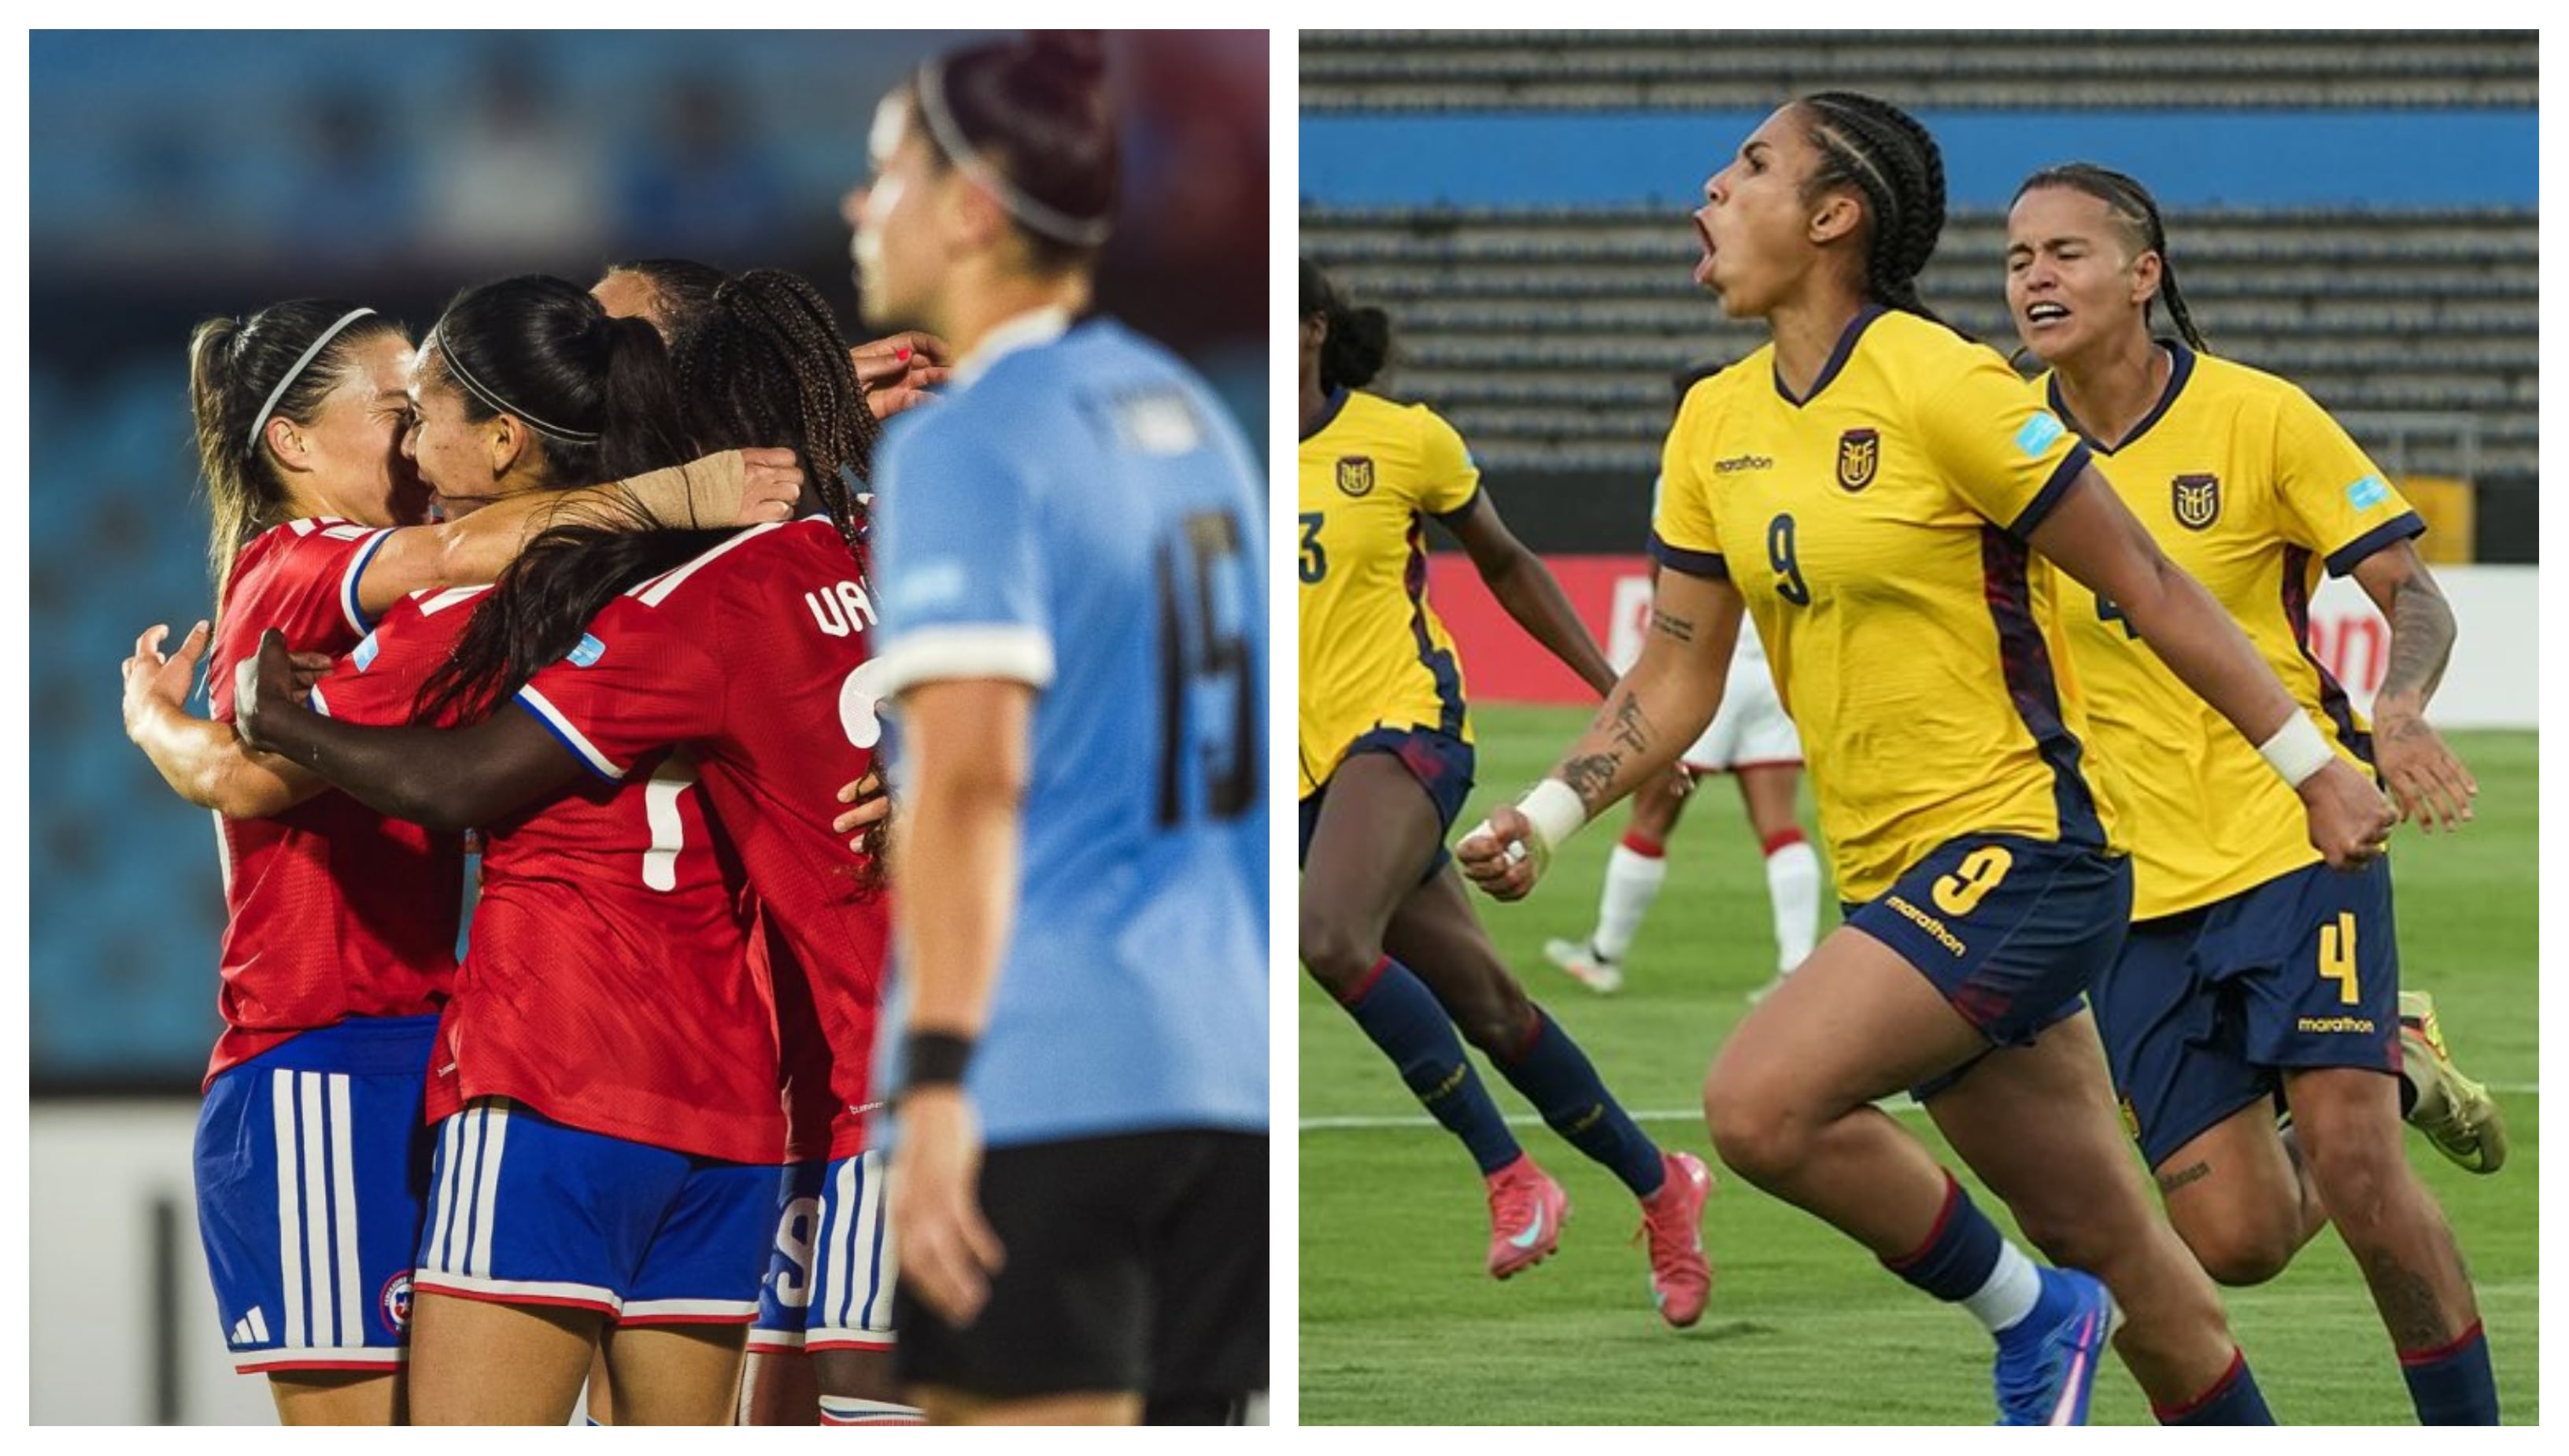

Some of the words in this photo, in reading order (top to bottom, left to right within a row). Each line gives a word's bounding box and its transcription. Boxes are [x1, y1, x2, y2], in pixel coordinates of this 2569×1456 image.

[1299, 512, 1327, 584] 3
[1768, 512, 1810, 606] 9
[804, 575, 878, 637] VA
[1152, 510, 1258, 833] 15
[1932, 845, 2013, 915] 9
[1885, 896, 1966, 957] marathon
[2319, 911, 2359, 1005] 4
[2297, 1016, 2375, 1034] marathon
